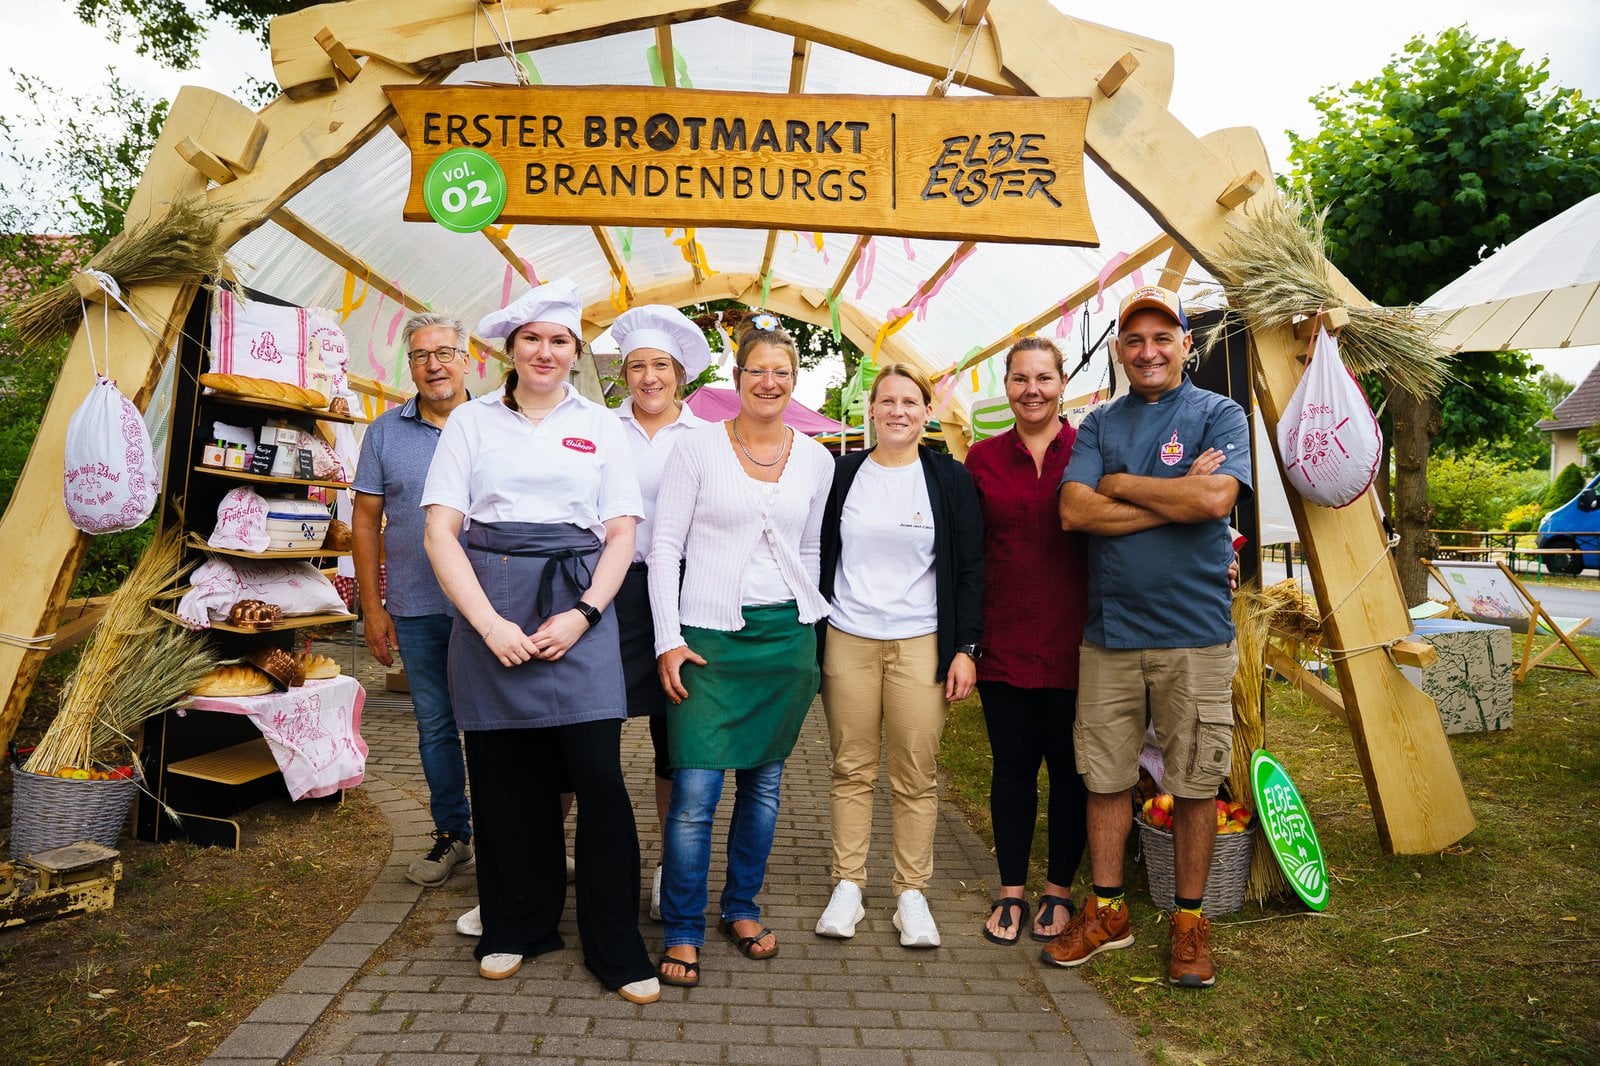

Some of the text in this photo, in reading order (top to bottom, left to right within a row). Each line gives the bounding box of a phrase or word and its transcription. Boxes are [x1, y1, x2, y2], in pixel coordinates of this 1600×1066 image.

[423, 112, 869, 154] ERSTER BROTMARKT
[932, 131, 1050, 168] ELBE
[441, 161, 476, 183] vol.
[525, 163, 867, 202] BRANDENBURGS
[920, 166, 1063, 209] ELSTER
[441, 179, 493, 213] 02
[1263, 784, 1299, 815] ELBE
[1268, 810, 1315, 846] ELSTER
